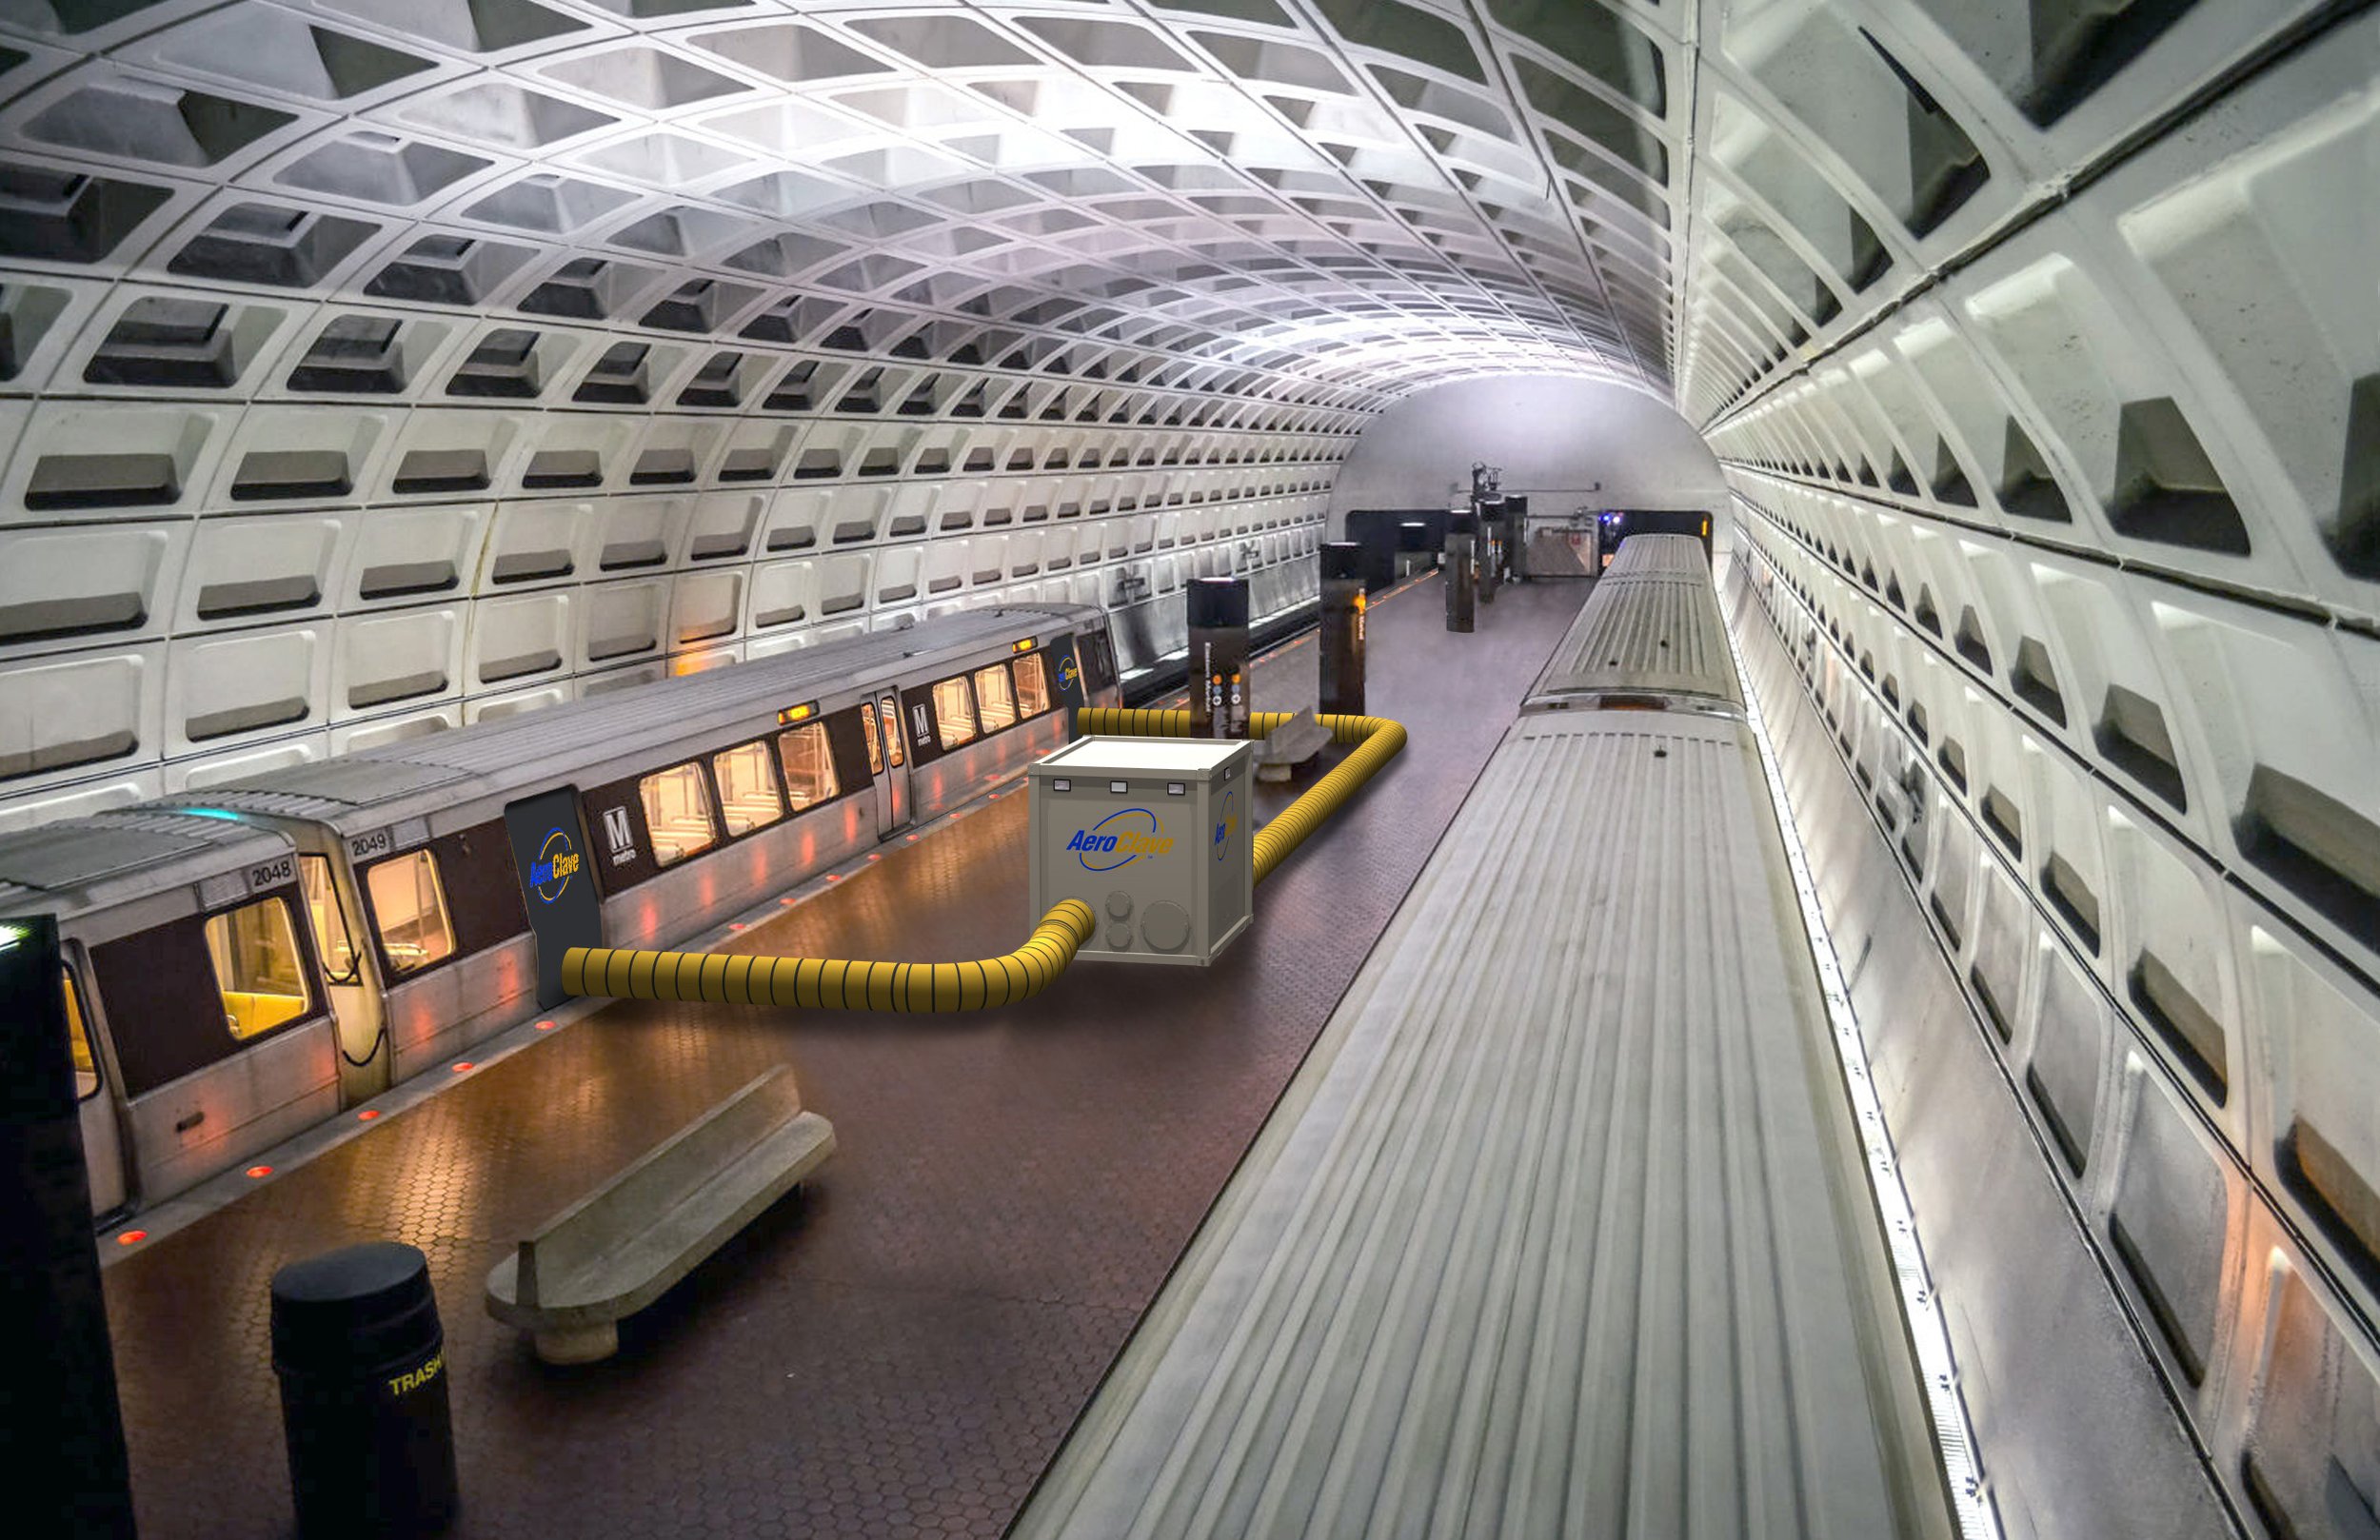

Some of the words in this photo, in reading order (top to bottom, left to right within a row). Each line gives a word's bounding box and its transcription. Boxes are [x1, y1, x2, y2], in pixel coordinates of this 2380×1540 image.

[605, 809, 631, 850] M
[1066, 829, 1174, 854] AeroClave
[351, 835, 387, 857] 2049
[252, 860, 291, 886] 2048
[530, 853, 579, 888] AeroClave
